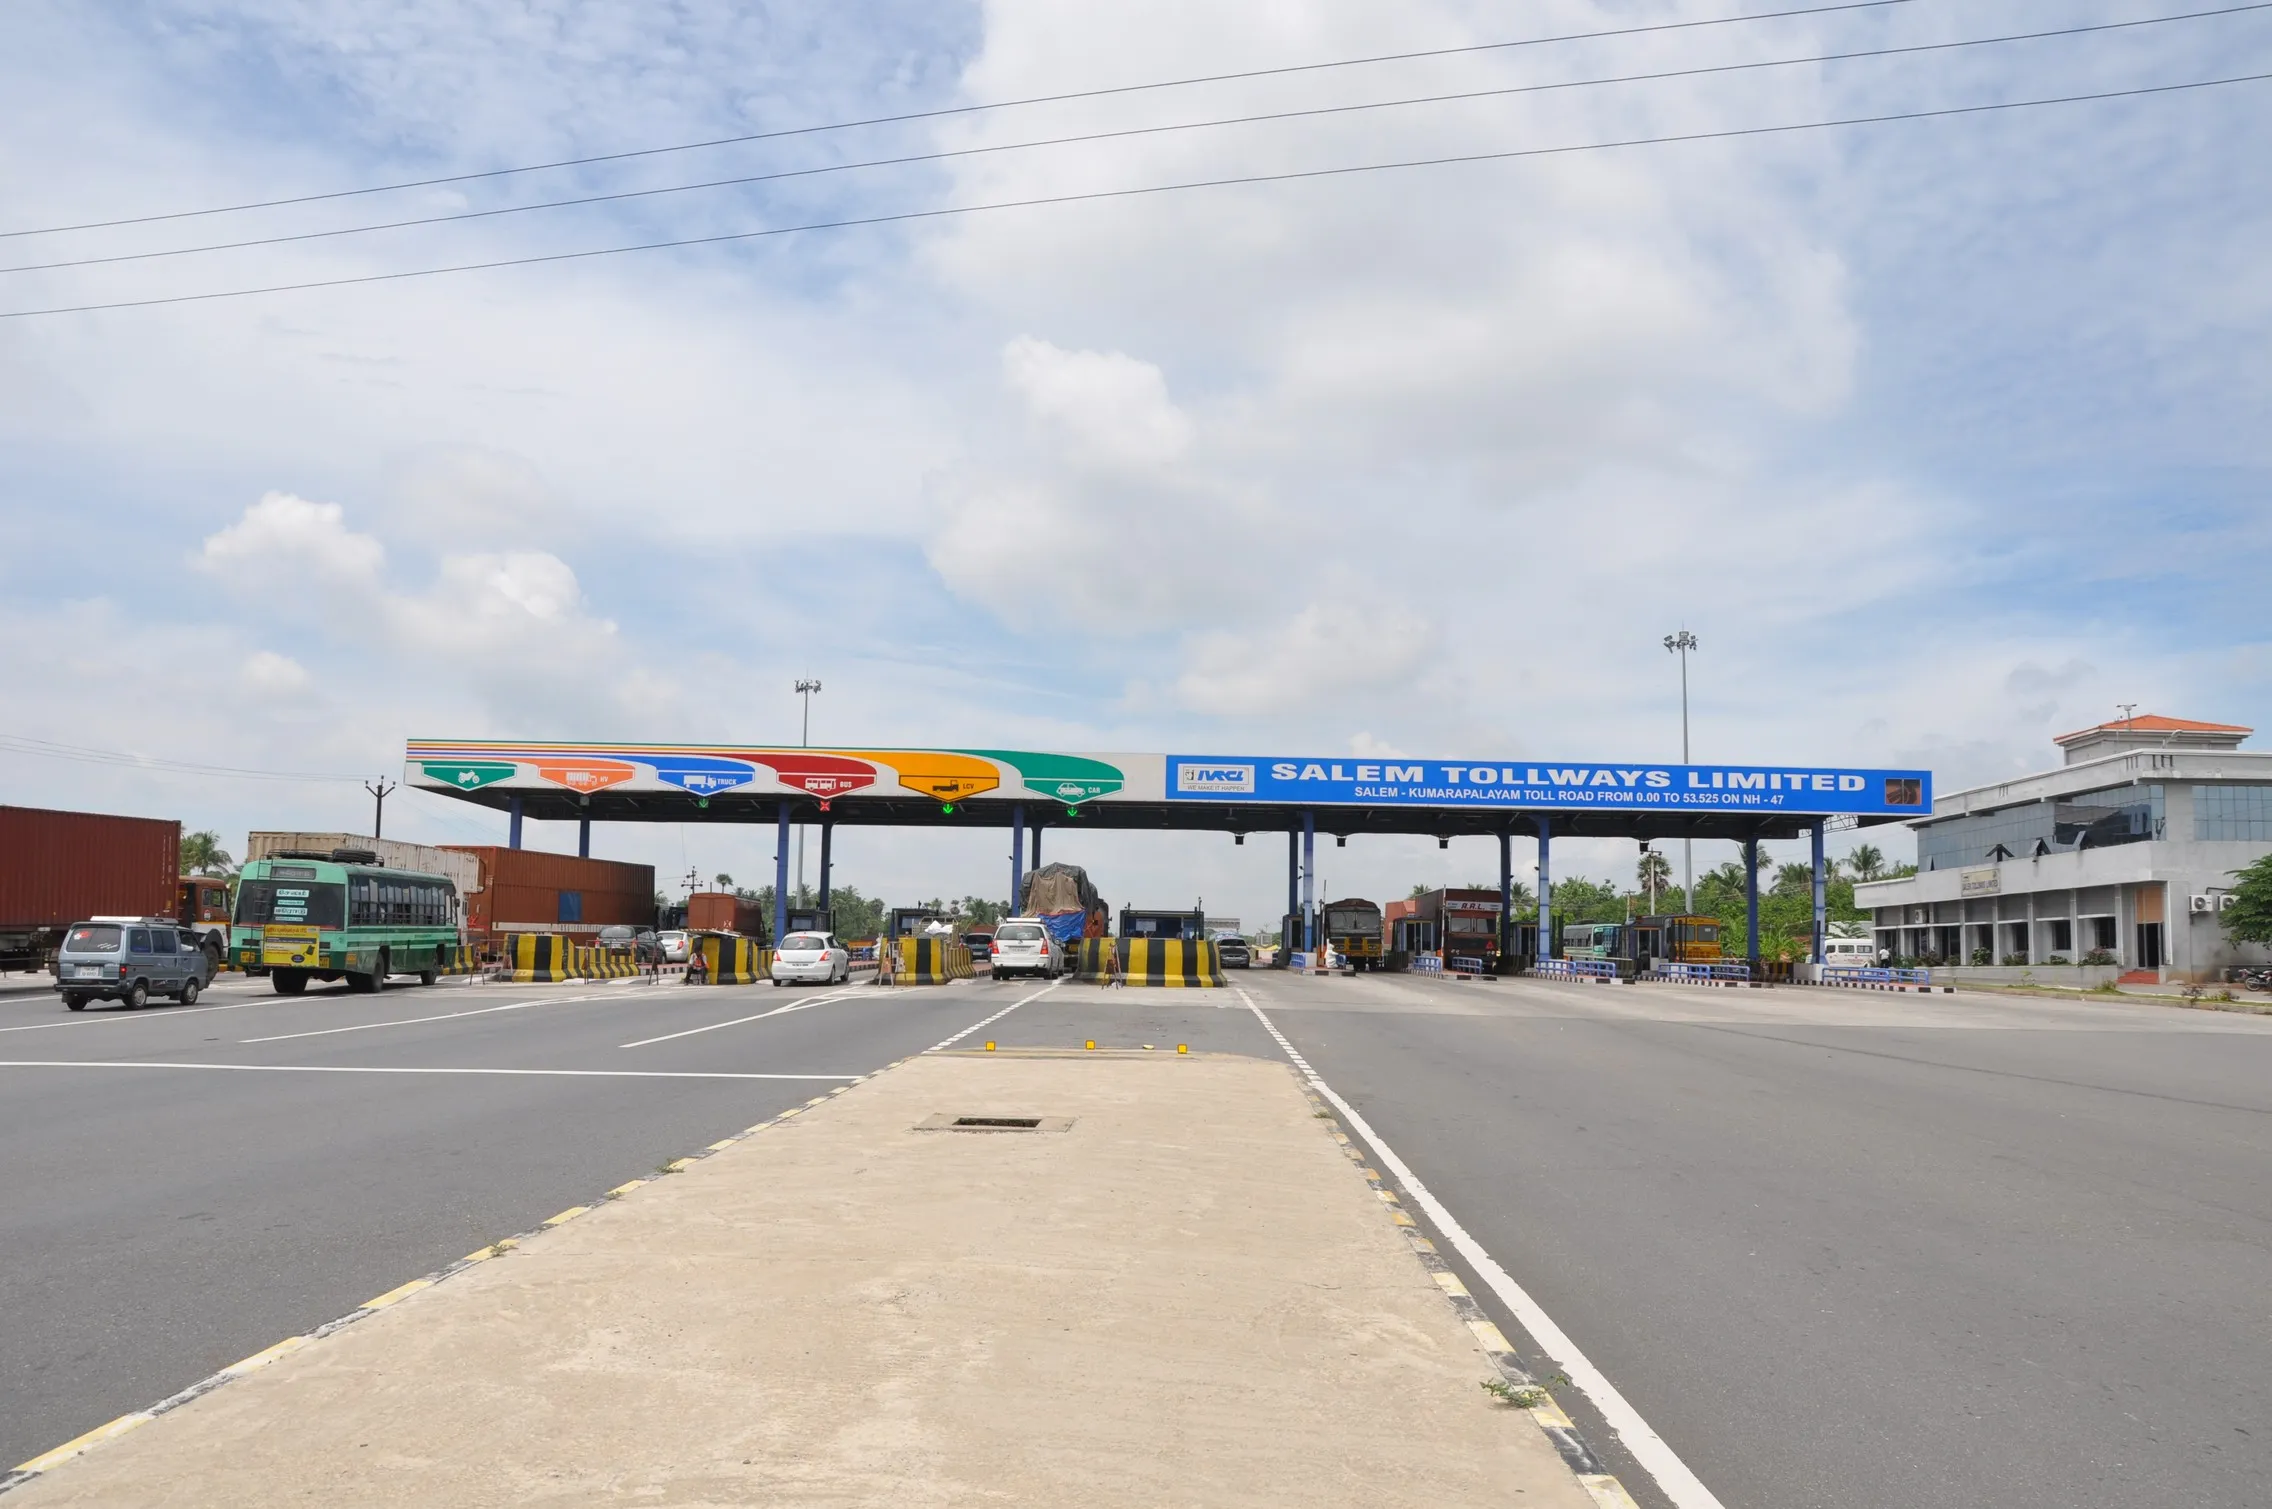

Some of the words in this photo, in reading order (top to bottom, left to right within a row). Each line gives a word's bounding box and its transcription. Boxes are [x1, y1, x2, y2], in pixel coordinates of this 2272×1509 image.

[1197, 769, 1244, 782] IVRCL
[1271, 763, 1423, 783] SALEM
[1440, 767, 1671, 788] TOLLWAYS
[1688, 771, 1866, 792] LIMITED
[1087, 786, 1101, 794] CAR
[1354, 786, 1398, 797] SALEM
[1408, 787, 1521, 800] KUMARAPALAYAM
[1524, 789, 1555, 801] TOLL
[1558, 790, 1594, 802] ROAD
[1598, 791, 1633, 802] FROM
[1636, 792, 1660, 803] 0.00
[1663, 792, 1680, 803] TO
[1682, 793, 1719, 804] 53.525
[1722, 793, 1740, 804] ON
[1743, 794, 1761, 804] NH
[1770, 794, 1784, 805] 47
